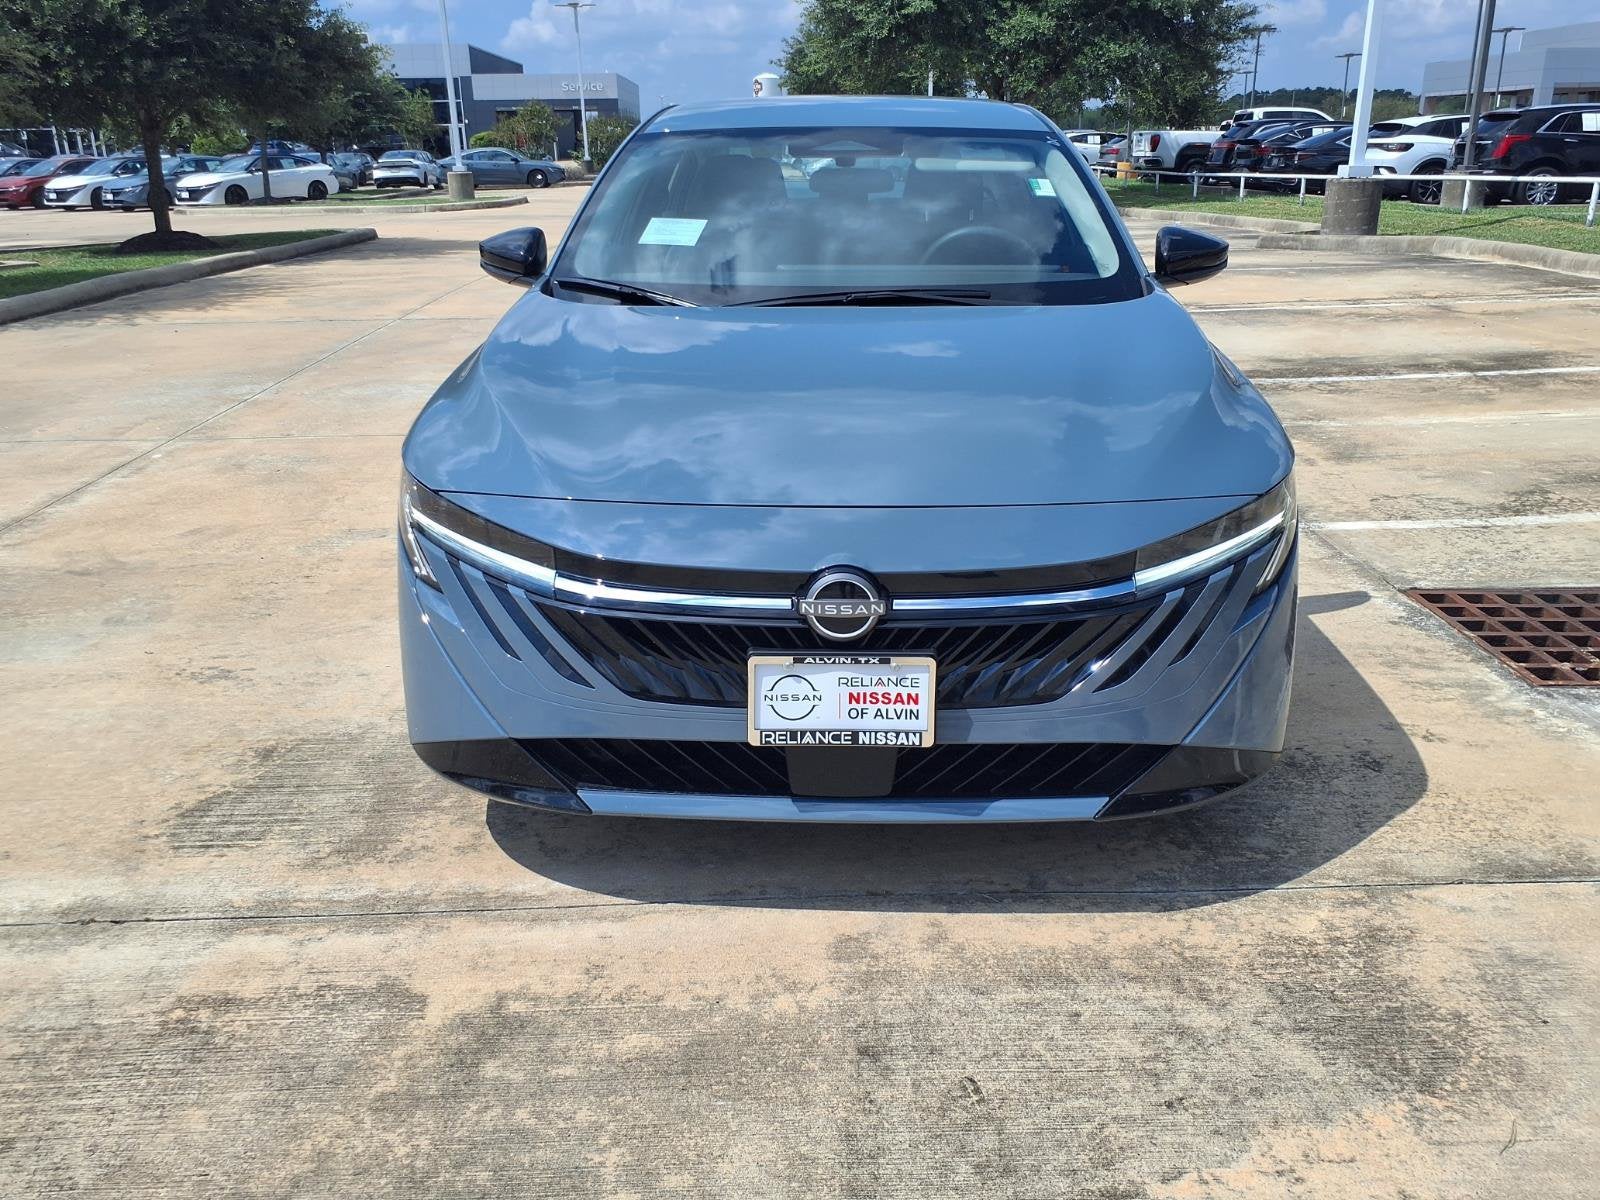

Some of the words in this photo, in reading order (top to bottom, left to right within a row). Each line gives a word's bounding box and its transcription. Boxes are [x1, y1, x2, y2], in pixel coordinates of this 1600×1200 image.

[801, 603, 884, 615] NISSAN
[838, 677, 920, 688] RELIANCE
[764, 694, 822, 702] NISSAN
[849, 692, 919, 706] NISSAN
[848, 708, 869, 720] OF
[873, 708, 919, 721] ALVIN
[762, 731, 852, 745] RELIANCE
[858, 732, 920, 746] NISSAN
